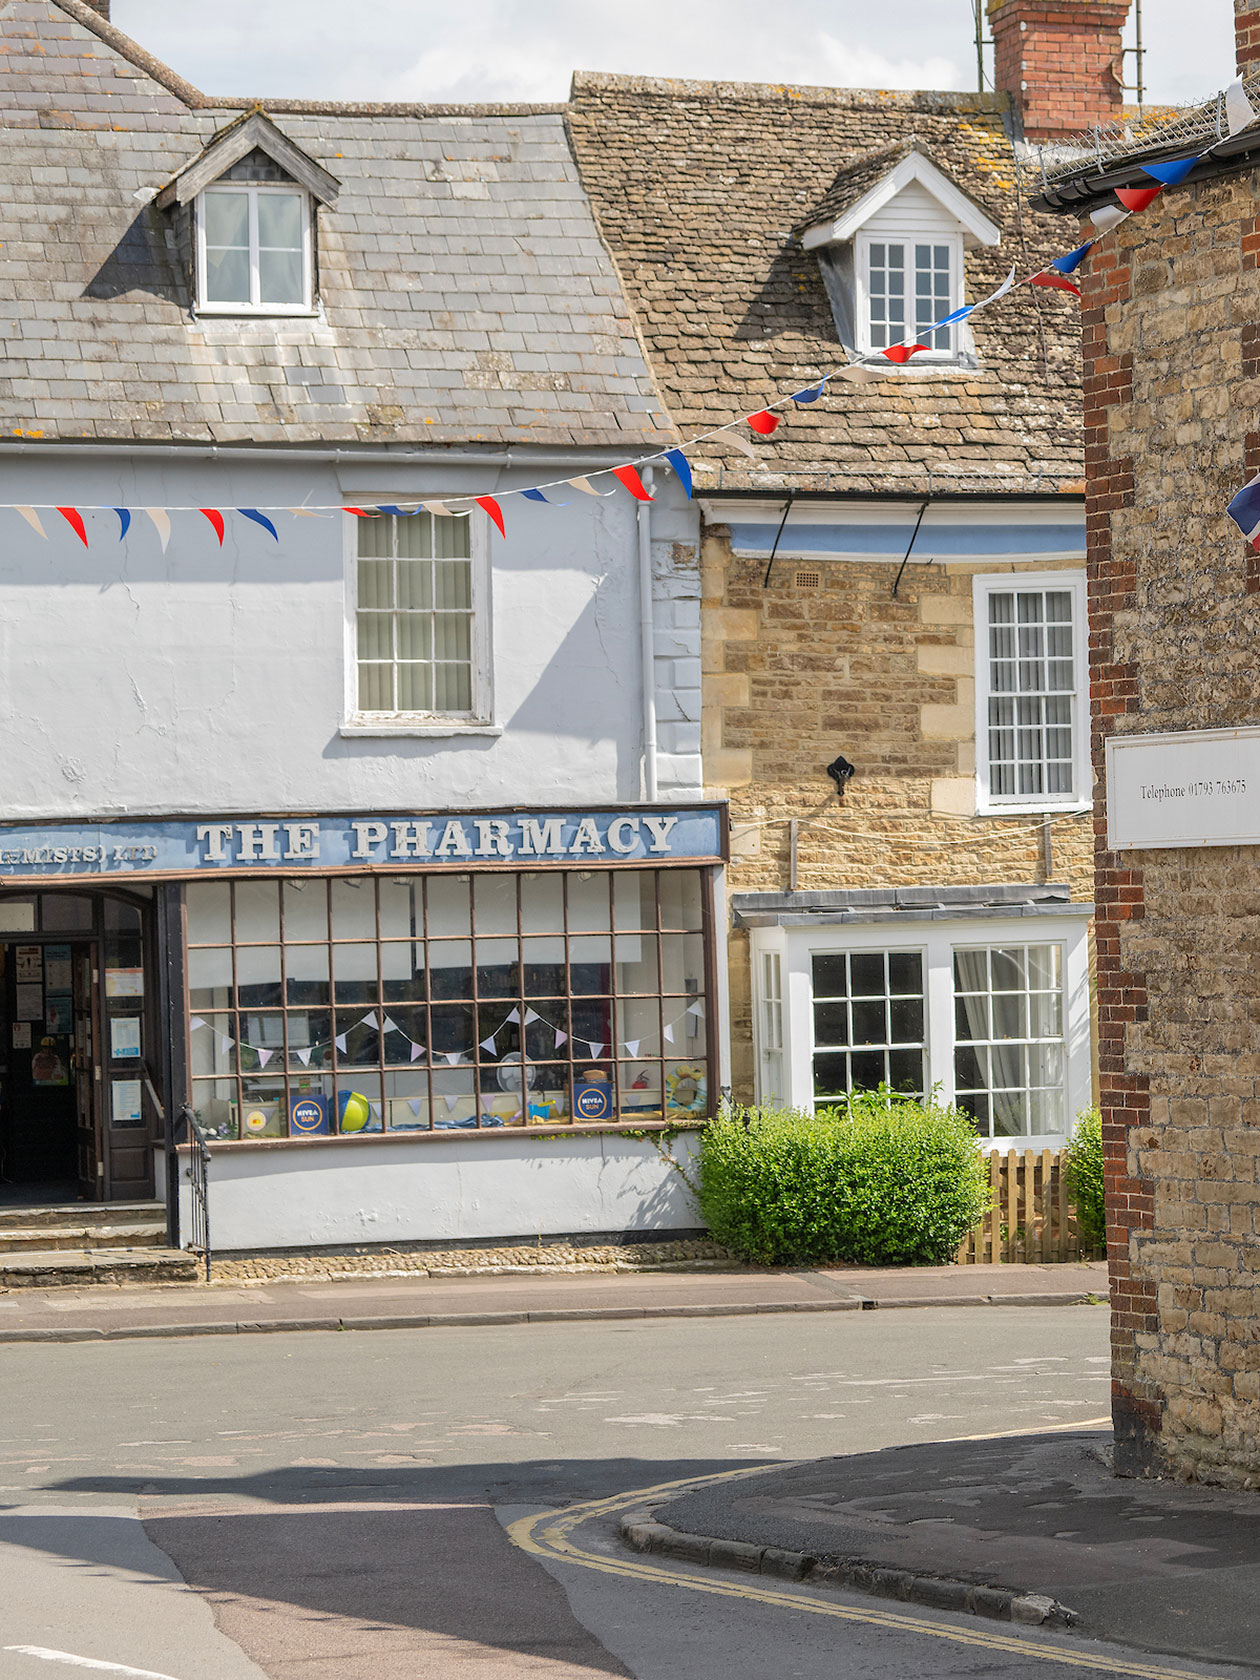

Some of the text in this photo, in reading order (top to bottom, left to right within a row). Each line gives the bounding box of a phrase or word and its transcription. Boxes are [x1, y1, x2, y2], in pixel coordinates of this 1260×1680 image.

[1139, 779, 1247, 803] Telephone 01793 763675
[197, 817, 678, 861] THE PHARMACY
[0, 845, 158, 865] EMISTS) LTD
[582, 1097, 603, 1105] NIVEA
[296, 1109, 319, 1117] NIVEA
[301, 1115, 315, 1123] SUN
